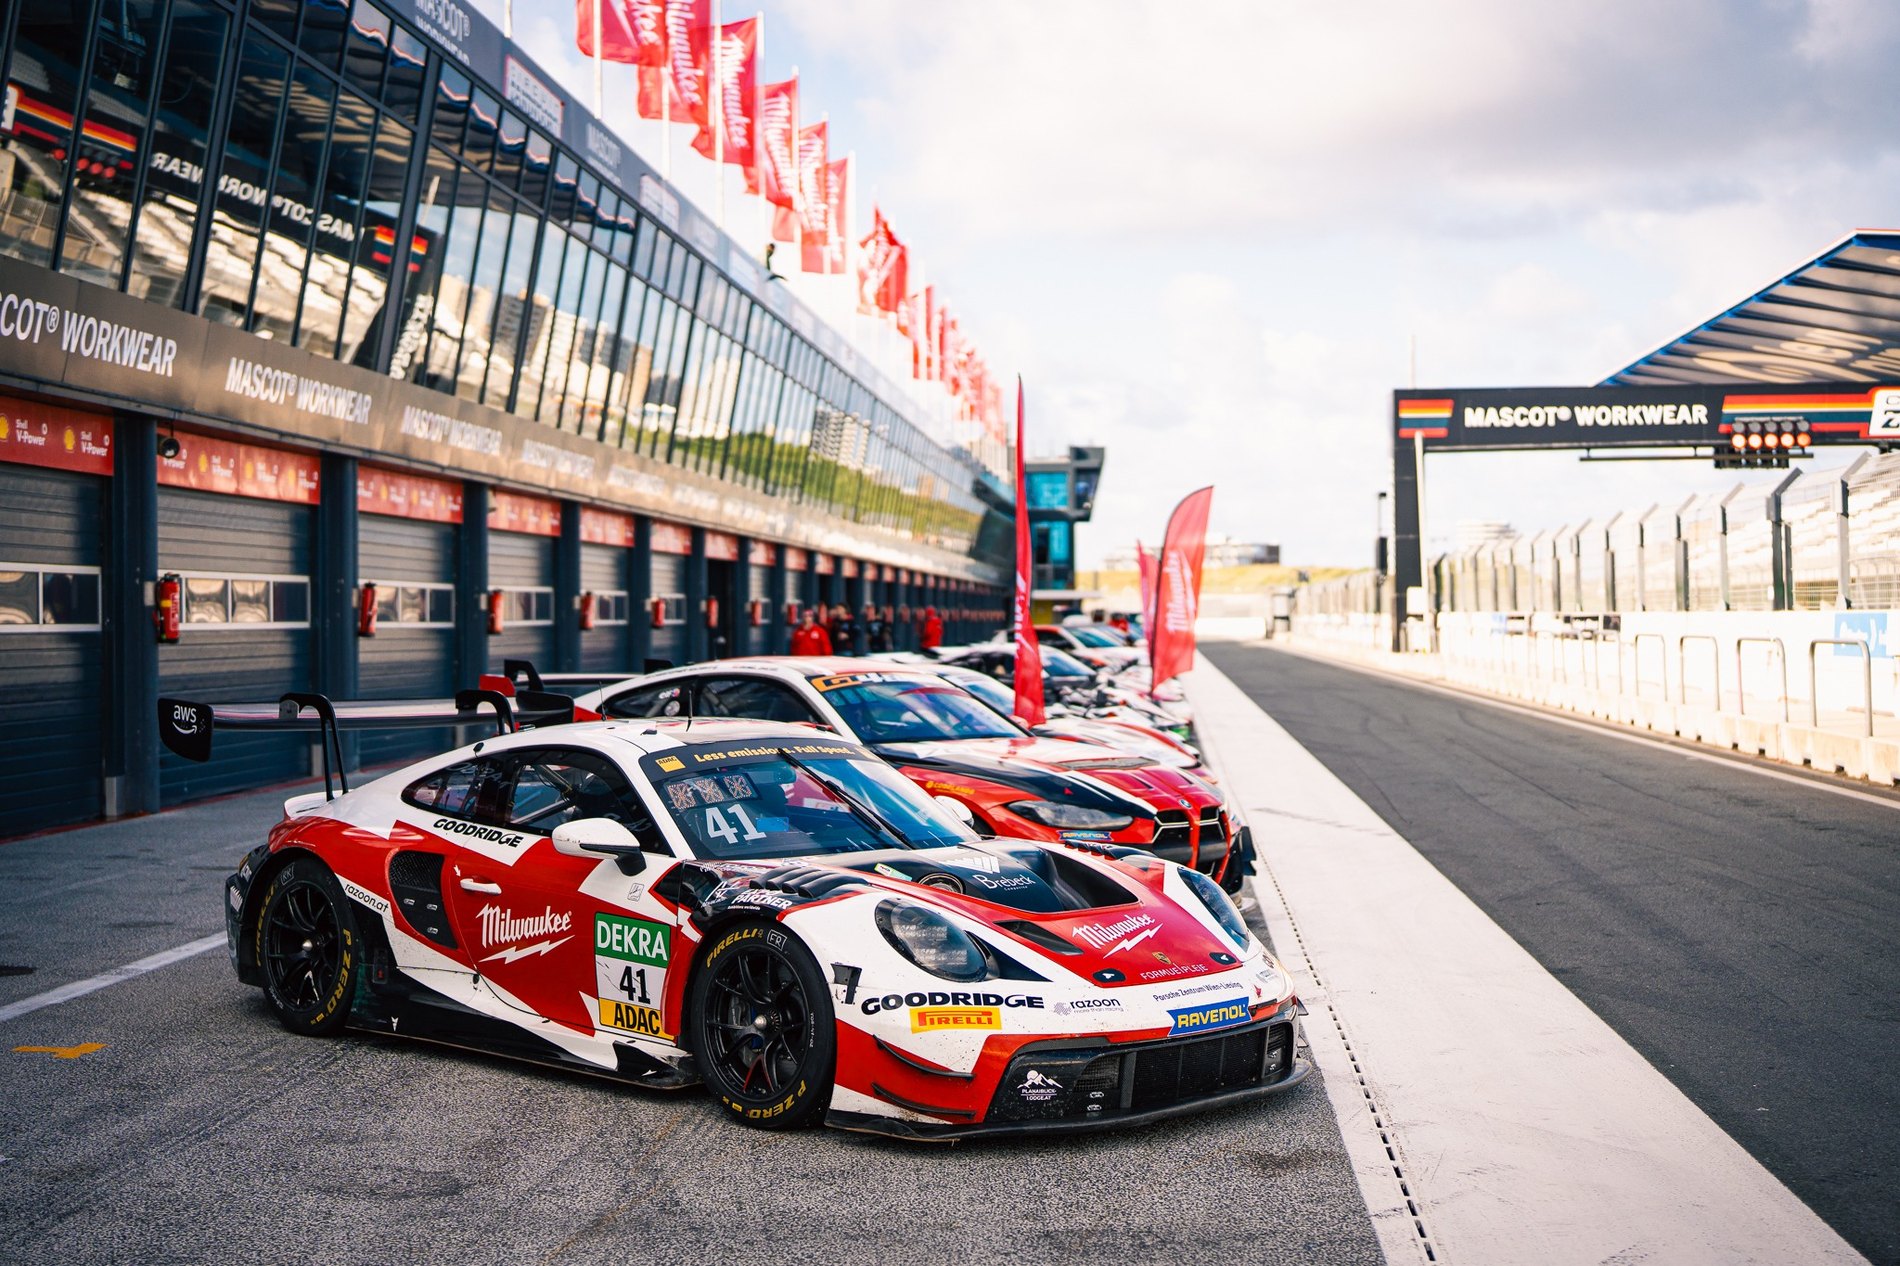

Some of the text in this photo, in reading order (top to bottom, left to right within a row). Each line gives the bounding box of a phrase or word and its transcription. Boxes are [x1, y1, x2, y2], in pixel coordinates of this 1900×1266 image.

[62, 310, 178, 378] WORKWEAR
[225, 357, 372, 425] MASCOT® WORKWEAR
[1574, 403, 1709, 427] WORKWEAR
[16, 429, 46, 446] V-Power
[81, 441, 108, 457] V-Power
[173, 705, 197, 723] aws
[656, 755, 678, 766] ADAC
[694, 750, 727, 763] Less
[795, 745, 818, 756] Full
[433, 818, 524, 848] GOODRIDGE
[705, 803, 767, 844] 41
[972, 874, 1036, 889] Brebeck
[345, 883, 389, 913] razoon.at
[731, 893, 793, 910] PARTNER
[476, 902, 573, 949] Milwaukee
[1072, 913, 1155, 949] Milwaukee
[596, 920, 668, 961] DEKRA
[706, 928, 758, 968] PIRELLI
[769, 932, 783, 947] FR
[326, 928, 352, 1014] P ZERO
[619, 965, 651, 1005] 41
[1152, 981, 1243, 1002] Porsche Zentrum Wien-Liesing
[861, 992, 1044, 1015] GOODRIDGE
[1070, 998, 1121, 1009] razoon
[613, 1003, 661, 1035] ADAC
[918, 1011, 993, 1026] PIRELLI
[1177, 1004, 1247, 1028] RAVENOL
[797, 1079, 808, 1098] P
[748, 1095, 796, 1119] ZERO
